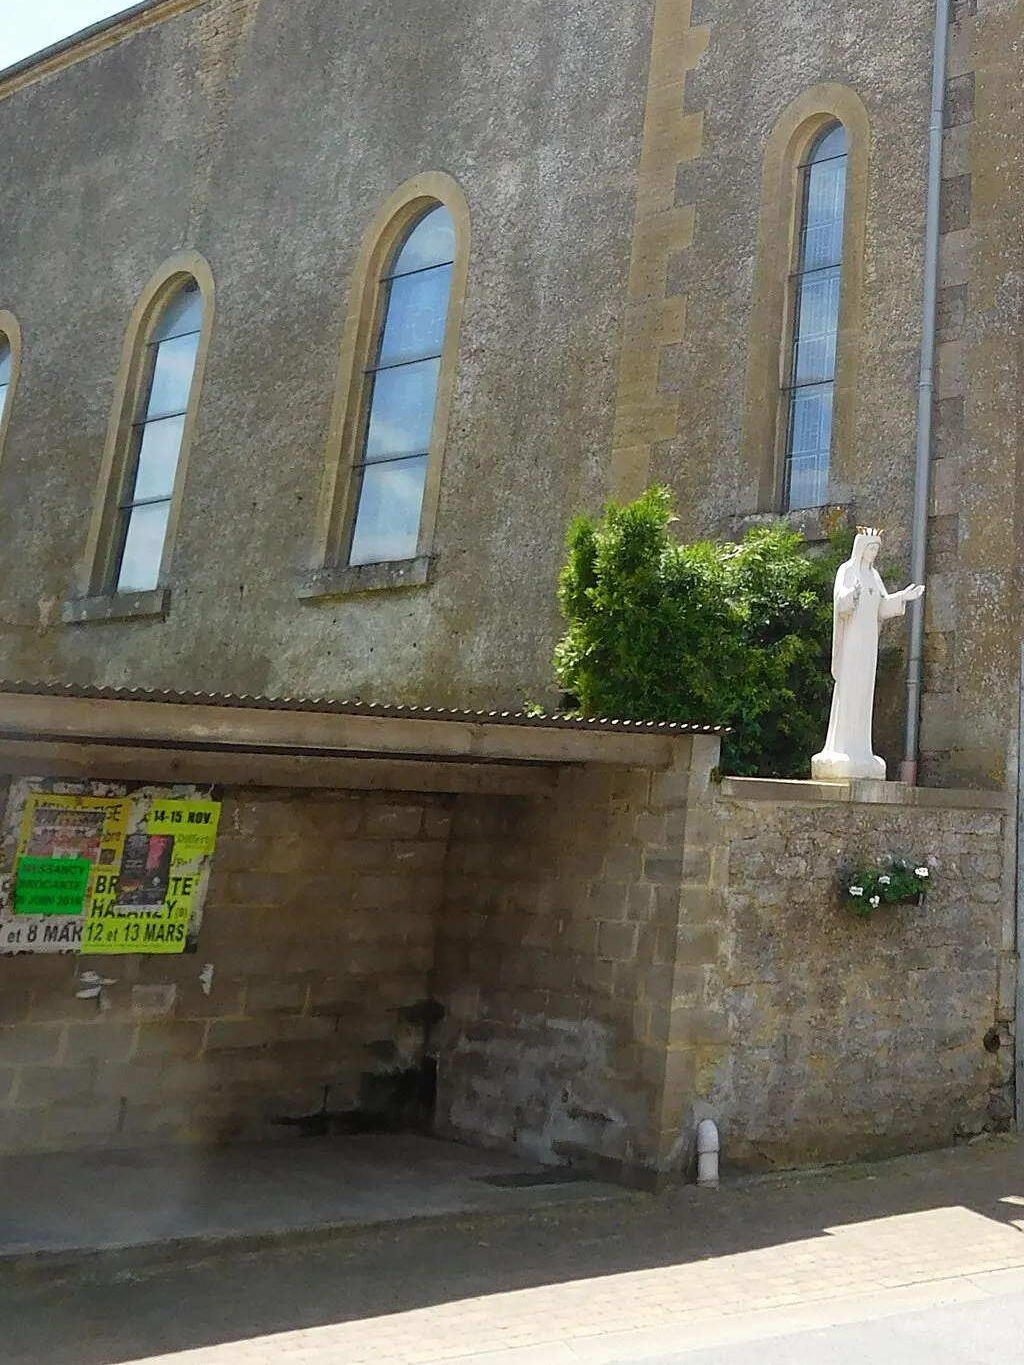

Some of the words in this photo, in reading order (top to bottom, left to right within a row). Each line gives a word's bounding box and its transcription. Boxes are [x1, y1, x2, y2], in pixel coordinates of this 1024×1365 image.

[154, 810, 182, 823] 14-15
[27, 925, 38, 942] 8
[43, 925, 83, 942] MAR
[88, 922, 104, 942] 12
[107, 928, 118, 942] et
[124, 923, 140, 942] 13
[143, 923, 185, 942] MARS
